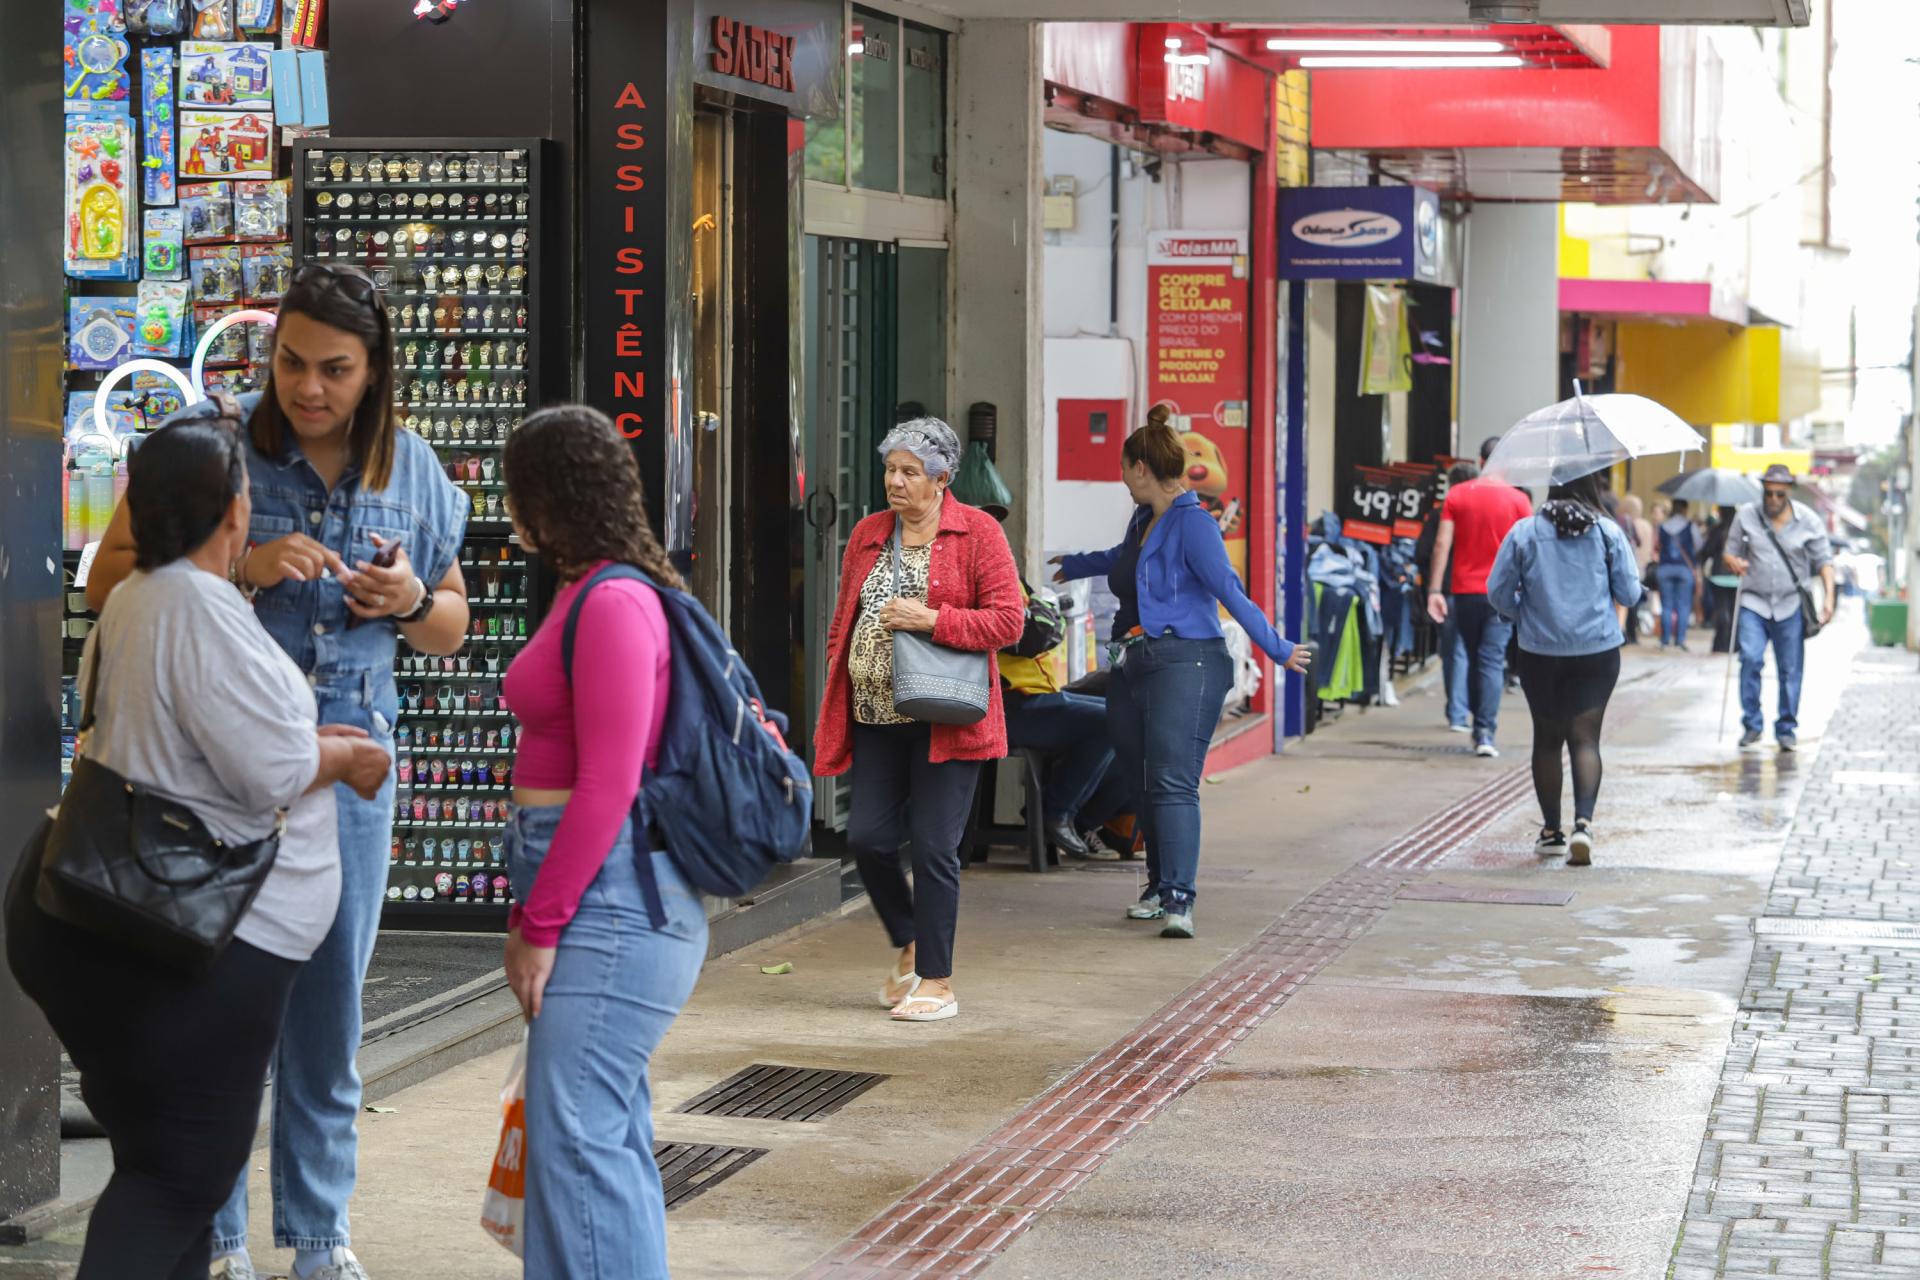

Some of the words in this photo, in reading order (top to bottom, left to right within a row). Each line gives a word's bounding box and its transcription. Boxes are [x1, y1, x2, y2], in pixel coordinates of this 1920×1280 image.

[304, 11, 316, 37] MOTOR
[712, 15, 797, 93] SADEK
[1159, 273, 1226, 288] COMPRE
[1159, 286, 1200, 299] PELO
[1159, 298, 1232, 311] CELULAR
[1159, 312, 1186, 323] COM
[1188, 312, 1199, 323] O
[1200, 312, 1241, 323] MENOR
[1159, 324, 1199, 336] PREÇO
[1200, 324, 1219, 335] DO
[1159, 336, 1199, 347] BRASIL
[1159, 348, 1168, 359] E
[1169, 348, 1213, 359] RETIRE
[1214, 348, 1225, 359] O
[1159, 361, 1219, 371] PRODUTO
[1159, 373, 1178, 383] NA
[1180, 373, 1215, 383] LOJA!
[1353, 489, 1391, 519] 49
